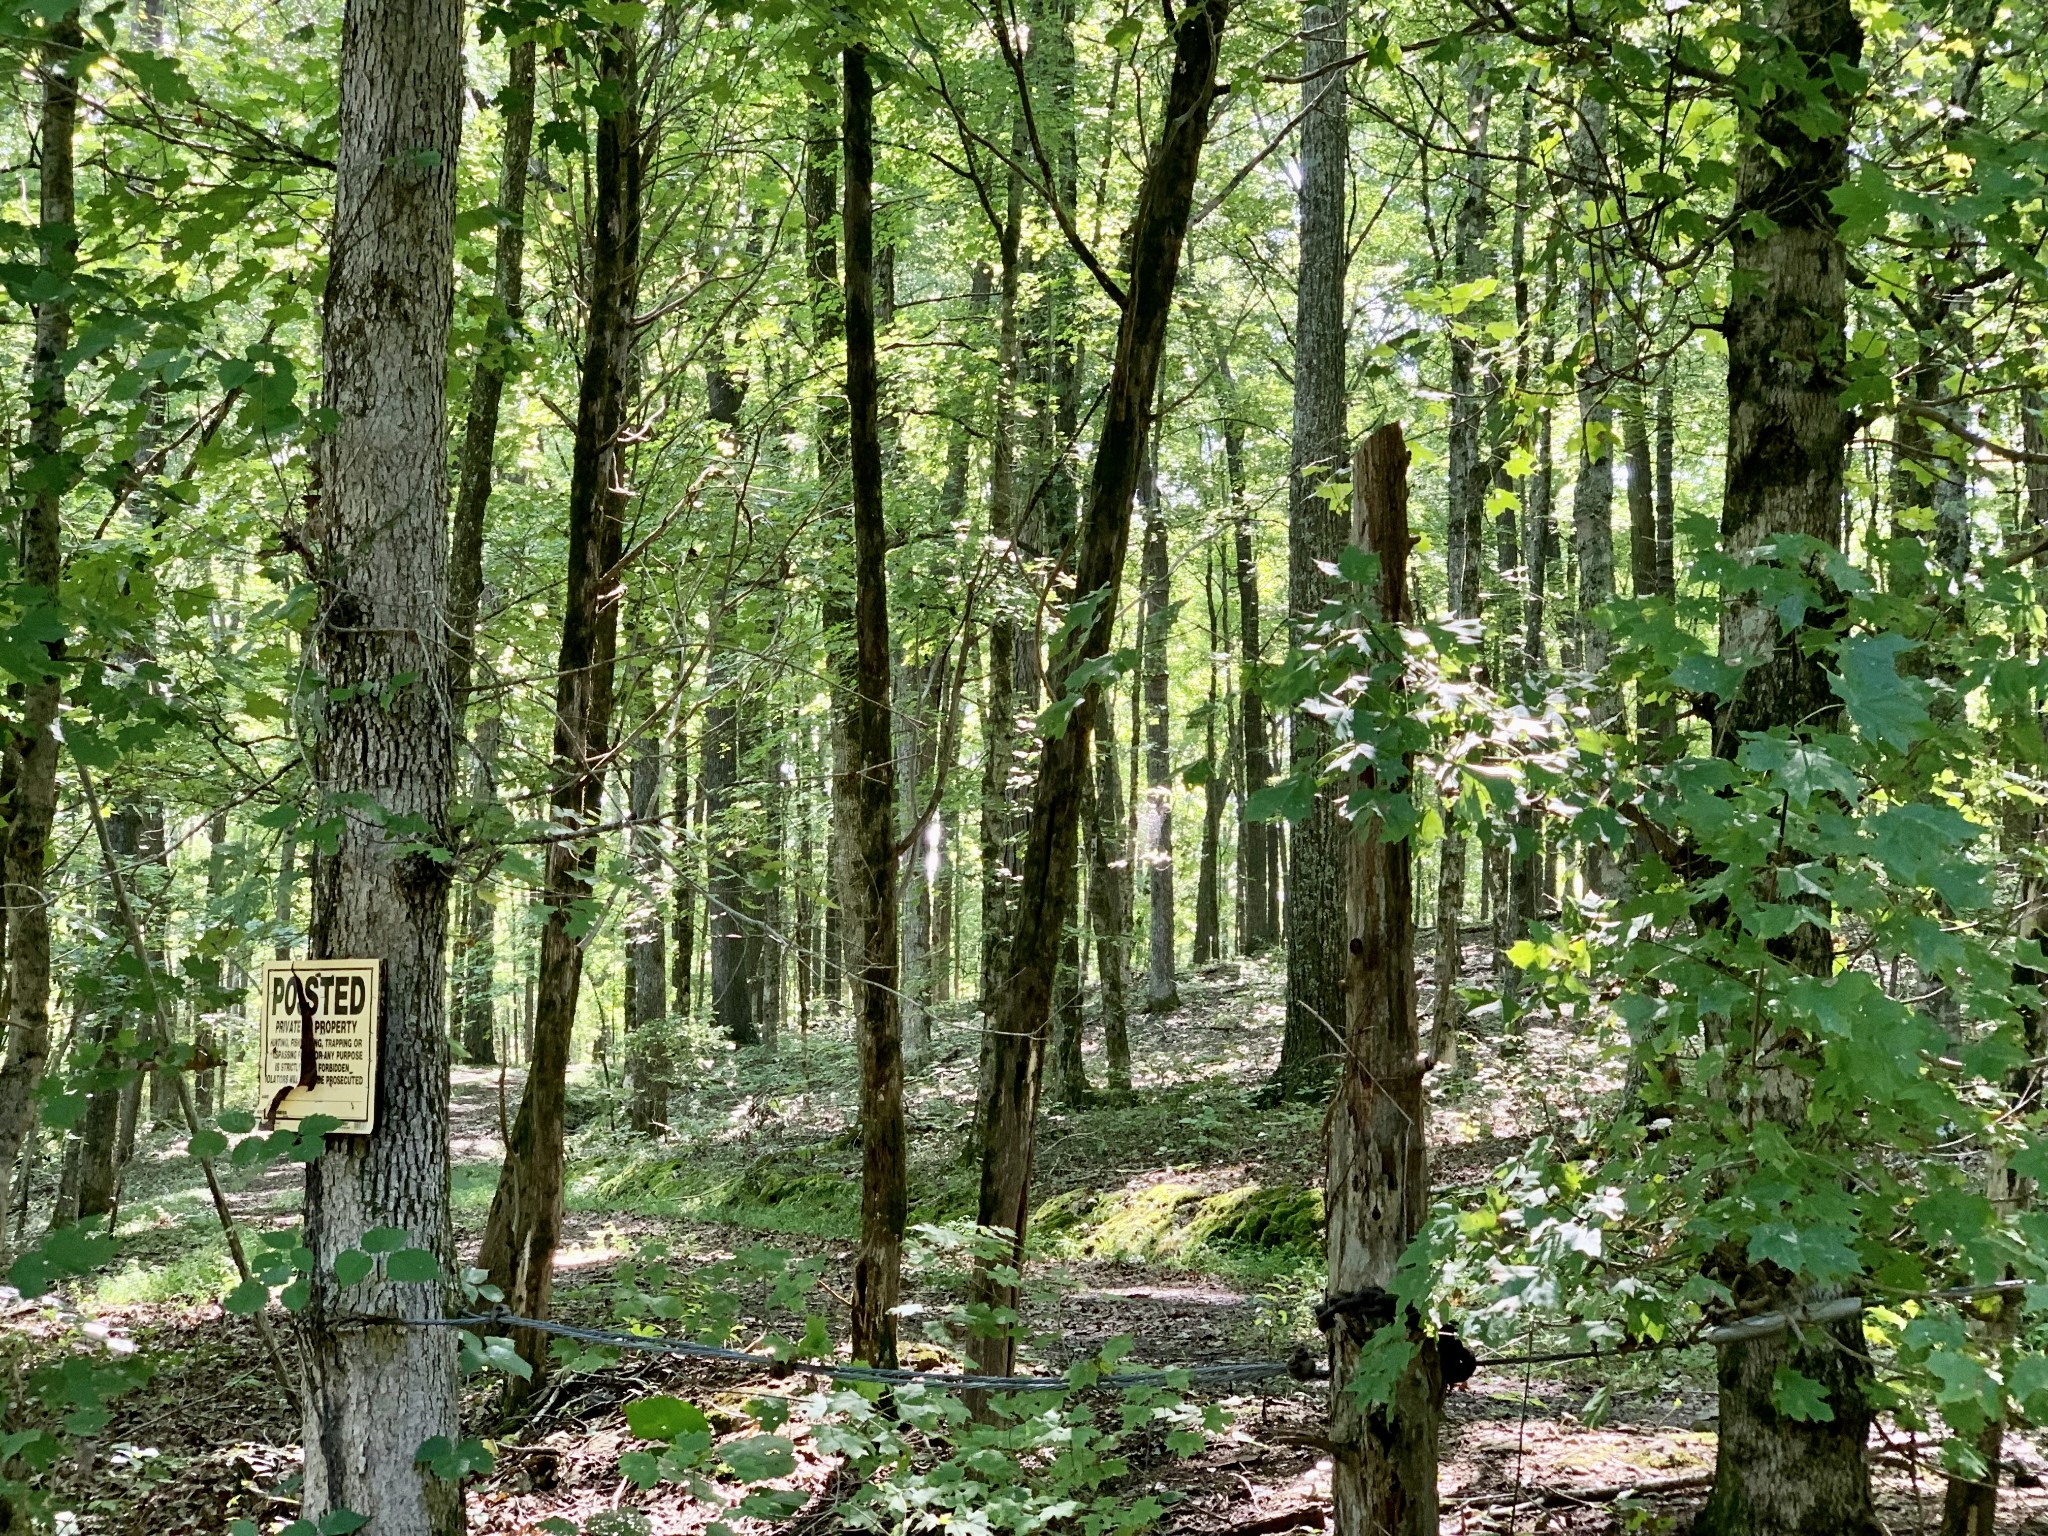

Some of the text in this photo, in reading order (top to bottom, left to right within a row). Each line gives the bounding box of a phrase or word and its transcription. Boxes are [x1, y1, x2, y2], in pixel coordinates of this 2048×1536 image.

[272, 976, 366, 1016] POSTED
[275, 1020, 358, 1034] PRIVATE PROPERTY
[325, 1038, 352, 1047] TRAPPING
[354, 1038, 363, 1047] OR
[336, 1050, 363, 1060] PURPOSE
[325, 1075, 363, 1086] PROSECUTED
